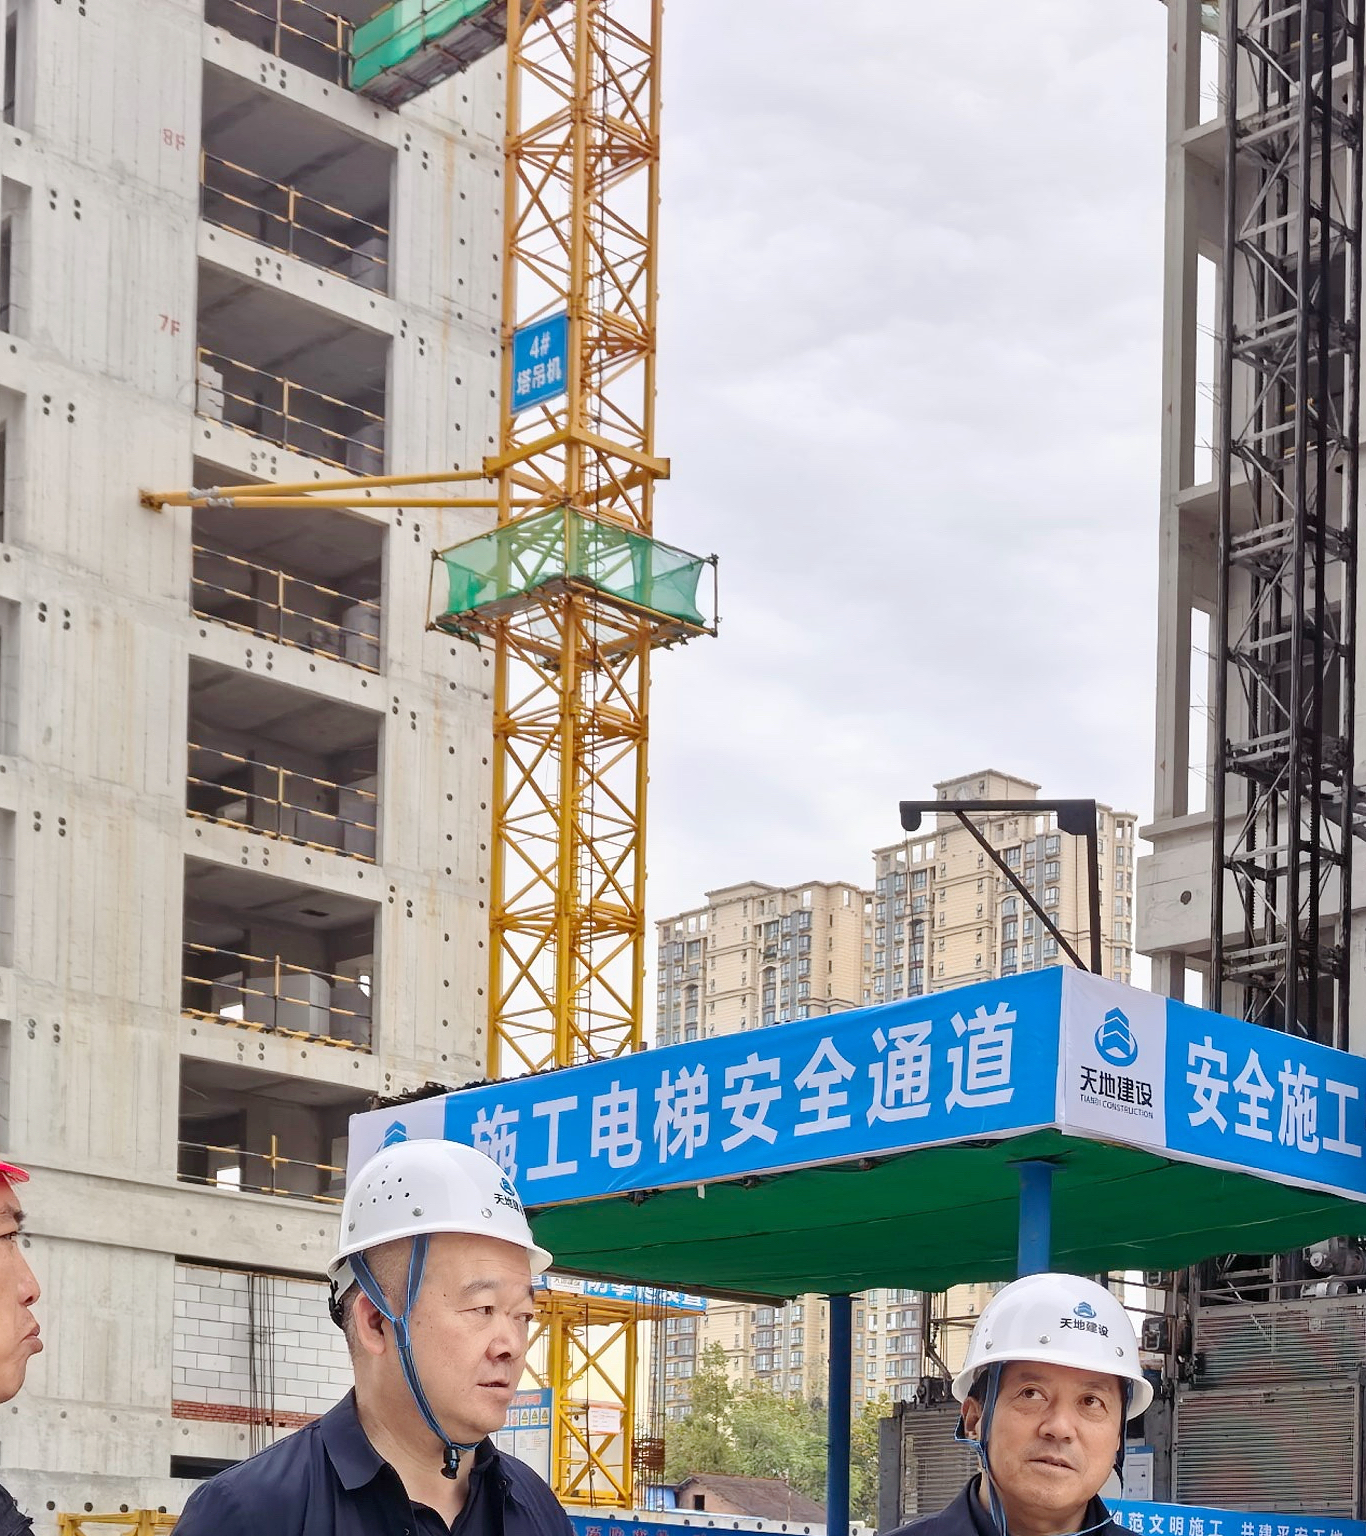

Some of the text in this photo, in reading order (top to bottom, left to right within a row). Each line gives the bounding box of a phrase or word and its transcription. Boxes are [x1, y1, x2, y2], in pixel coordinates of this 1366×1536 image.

[159, 314, 180, 336] 7F
[529, 331, 551, 358] 4#
[471, 1002, 1018, 1184] 施工电梯安全通道
[1080, 1065, 1153, 1108] 天地建设
[1060, 1318, 1109, 1338] 天地建设
